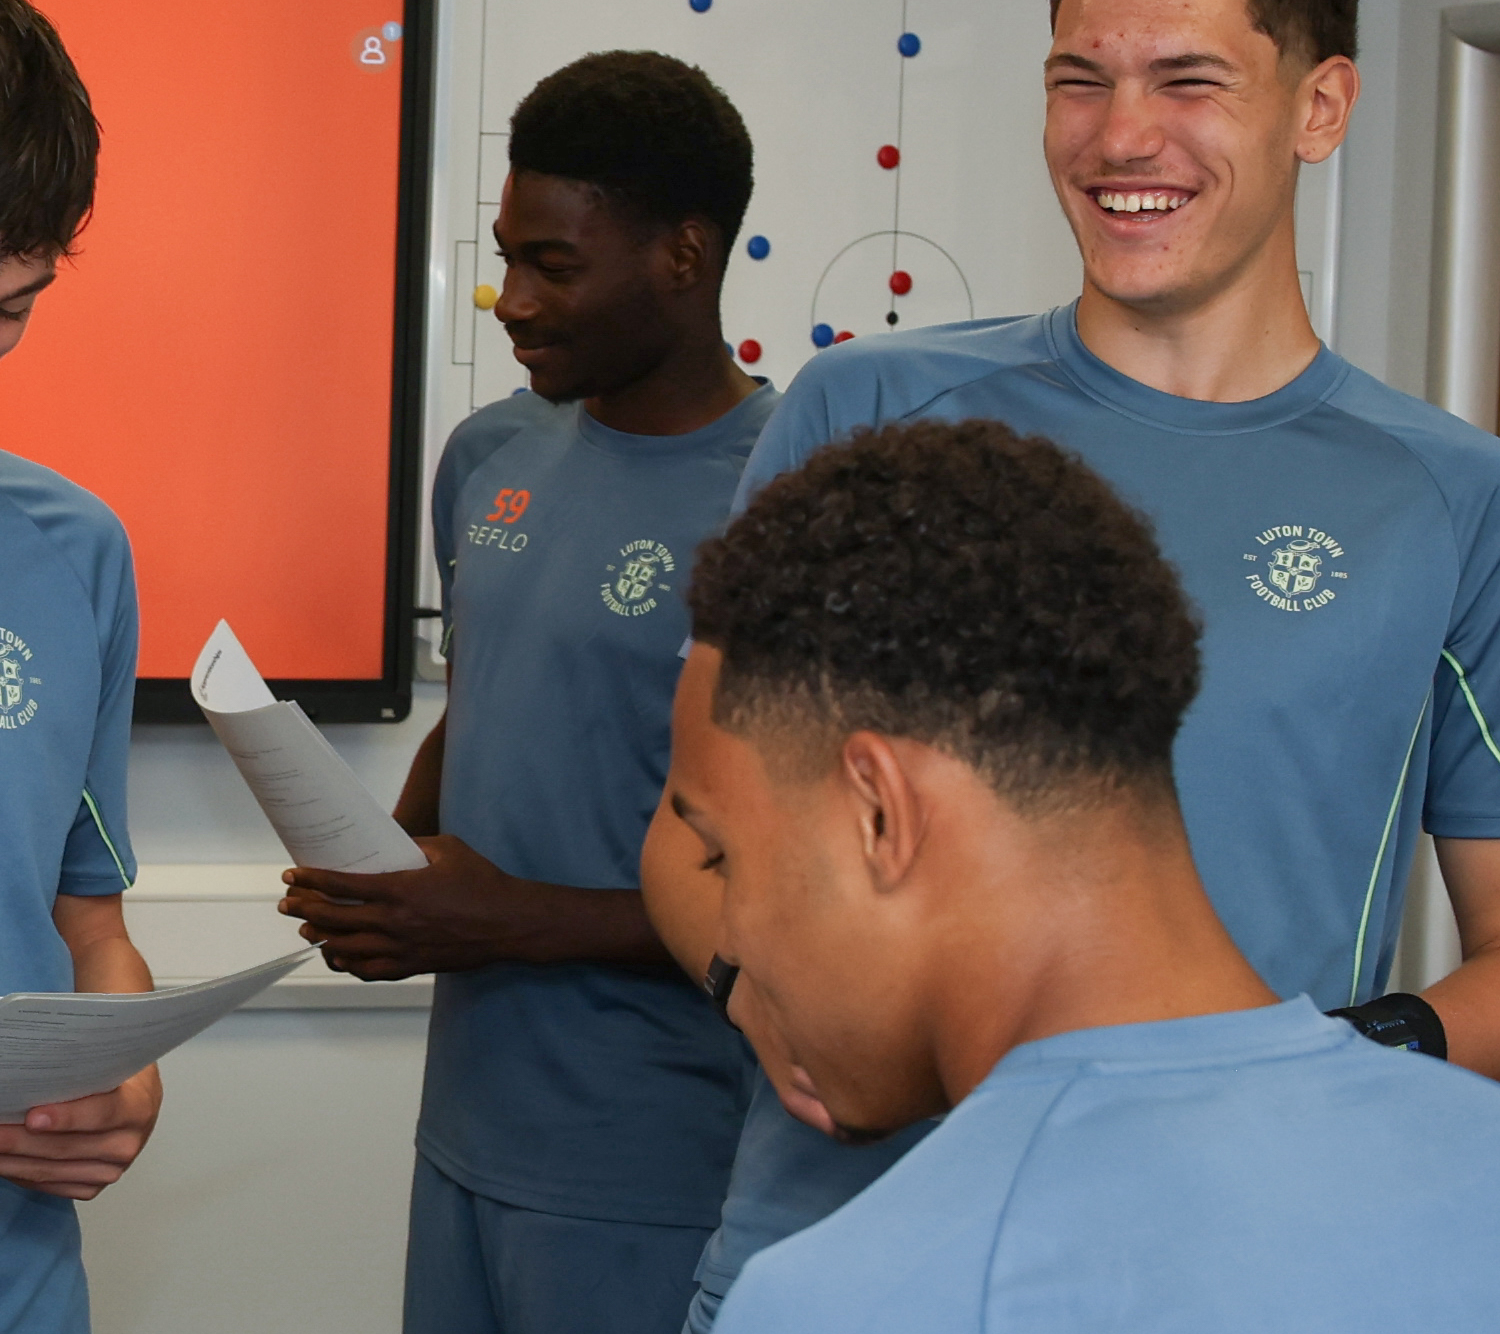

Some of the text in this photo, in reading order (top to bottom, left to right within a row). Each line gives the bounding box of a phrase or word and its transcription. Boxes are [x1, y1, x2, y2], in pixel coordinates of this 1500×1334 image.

[485, 488, 531, 524] 59
[467, 524, 528, 553] REFLO
[620, 539, 675, 572] LUTON TOWN
[1255, 525, 1345, 559] LUTON TOWN
[600, 582, 658, 617] FOOTBALL CLUB
[1245, 573, 1336, 612] FOOTBALL CLUB
[18, 698, 39, 727] CLUB
